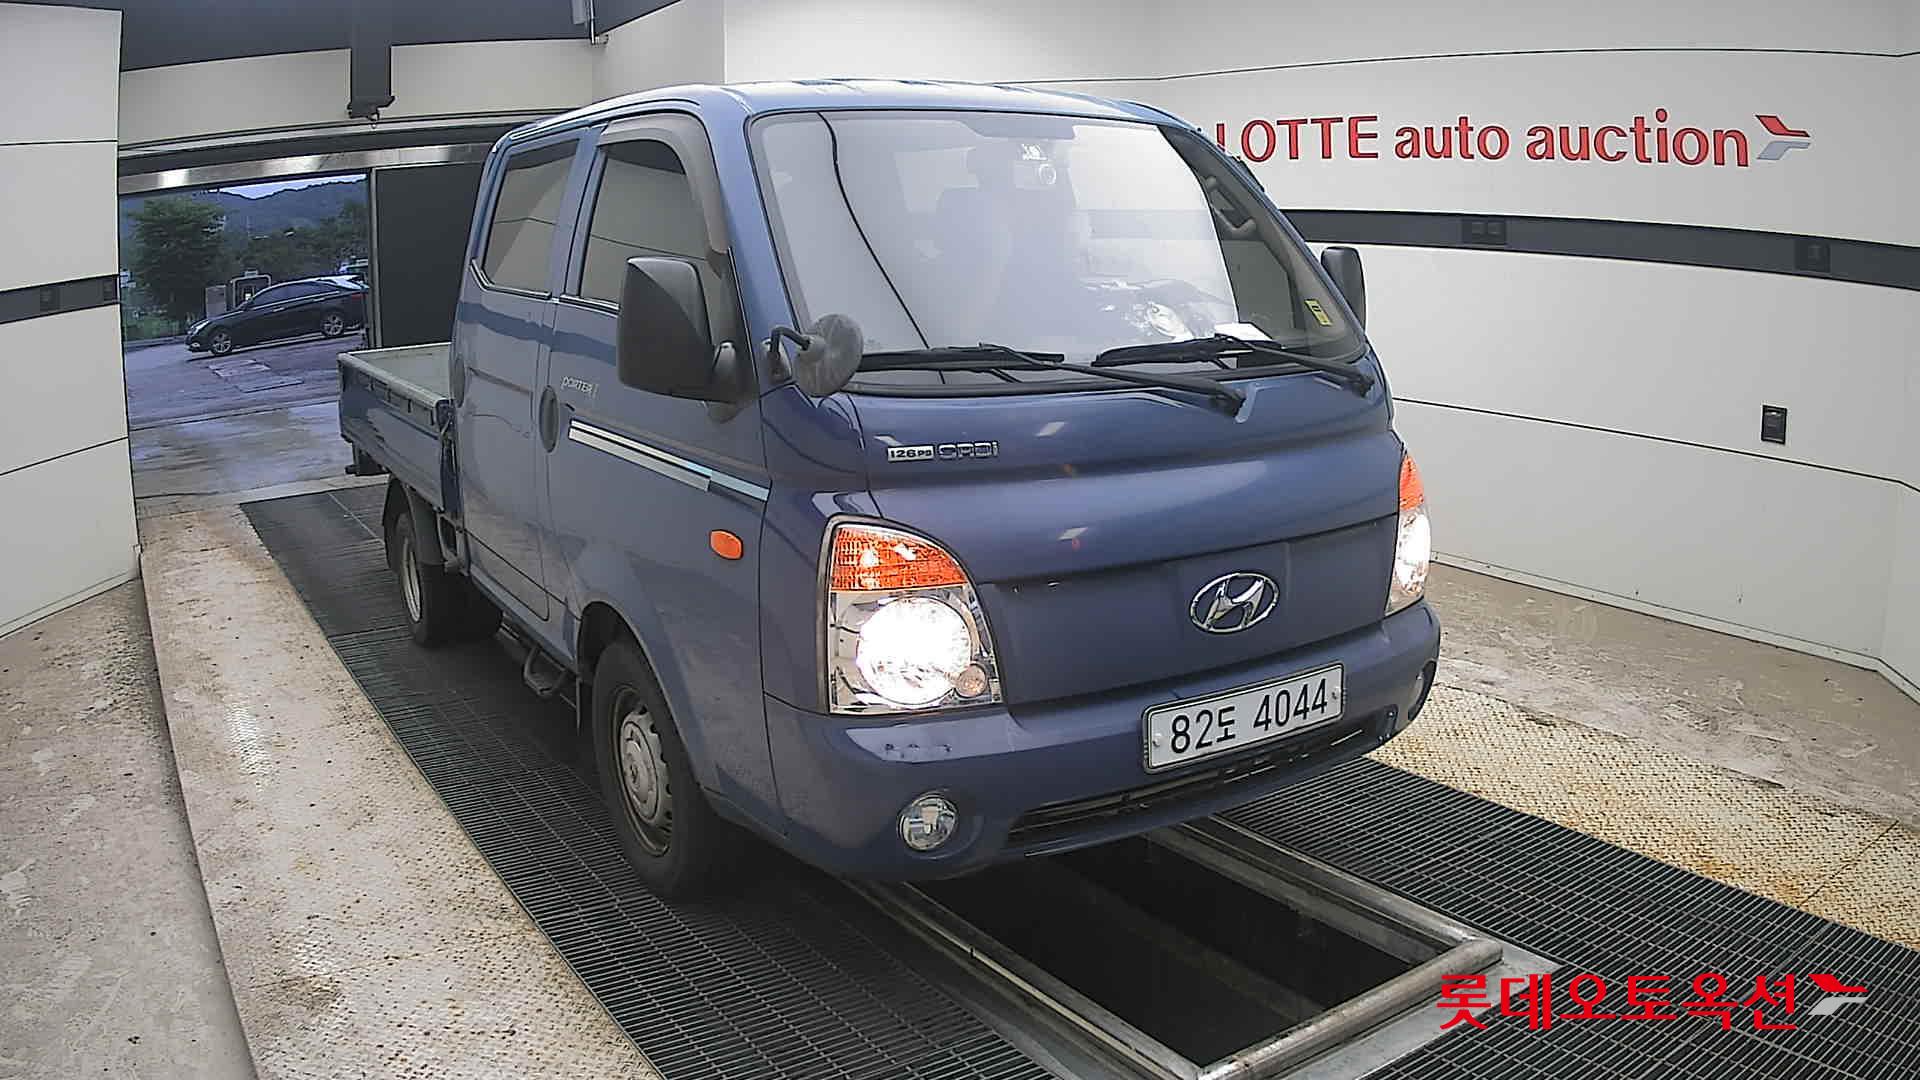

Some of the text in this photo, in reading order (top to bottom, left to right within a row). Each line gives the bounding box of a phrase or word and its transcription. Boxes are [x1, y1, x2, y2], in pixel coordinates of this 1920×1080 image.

[1394, 117, 1510, 160] auto
[1526, 109, 1749, 167] auction
[560, 376, 592, 393] PORTER
[1171, 678, 1328, 754] 82도 4044
